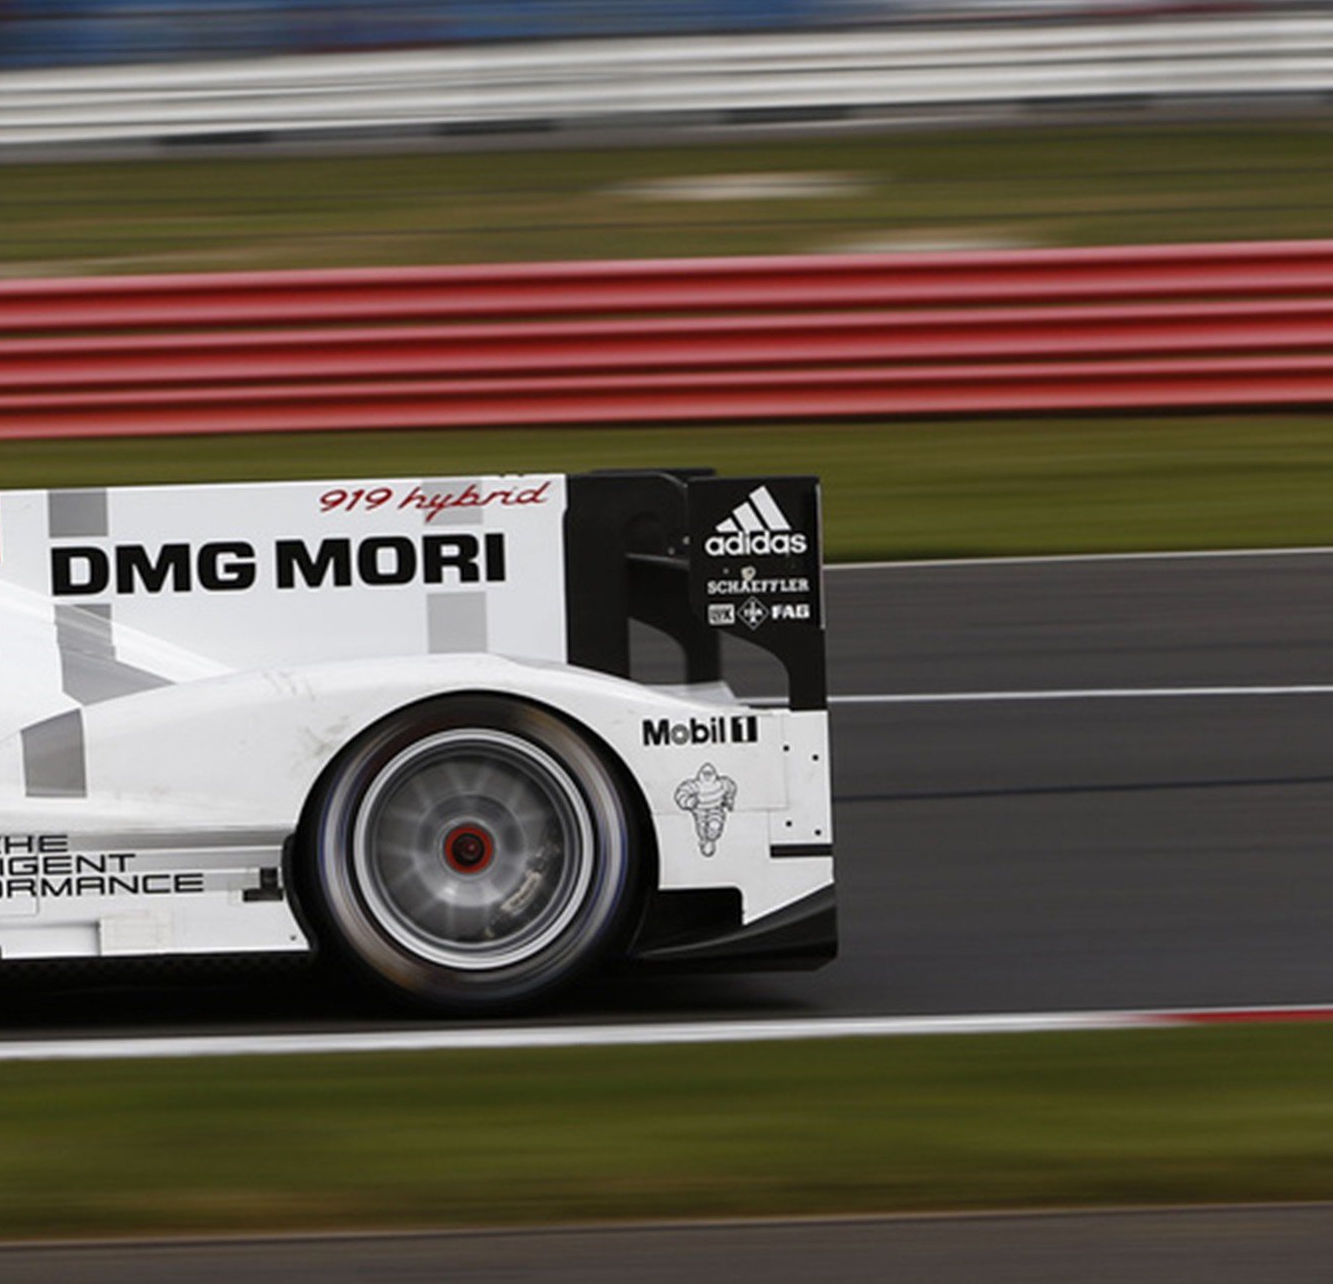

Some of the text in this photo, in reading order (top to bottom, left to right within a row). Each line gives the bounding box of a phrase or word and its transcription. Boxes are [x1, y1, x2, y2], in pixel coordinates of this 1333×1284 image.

[319, 481, 552, 522] 919 hybrid
[704, 529, 808, 556] adidas
[50, 532, 506, 596] DMG MORI
[771, 603, 811, 619] FAG
[642, 717, 726, 746] Mobil
